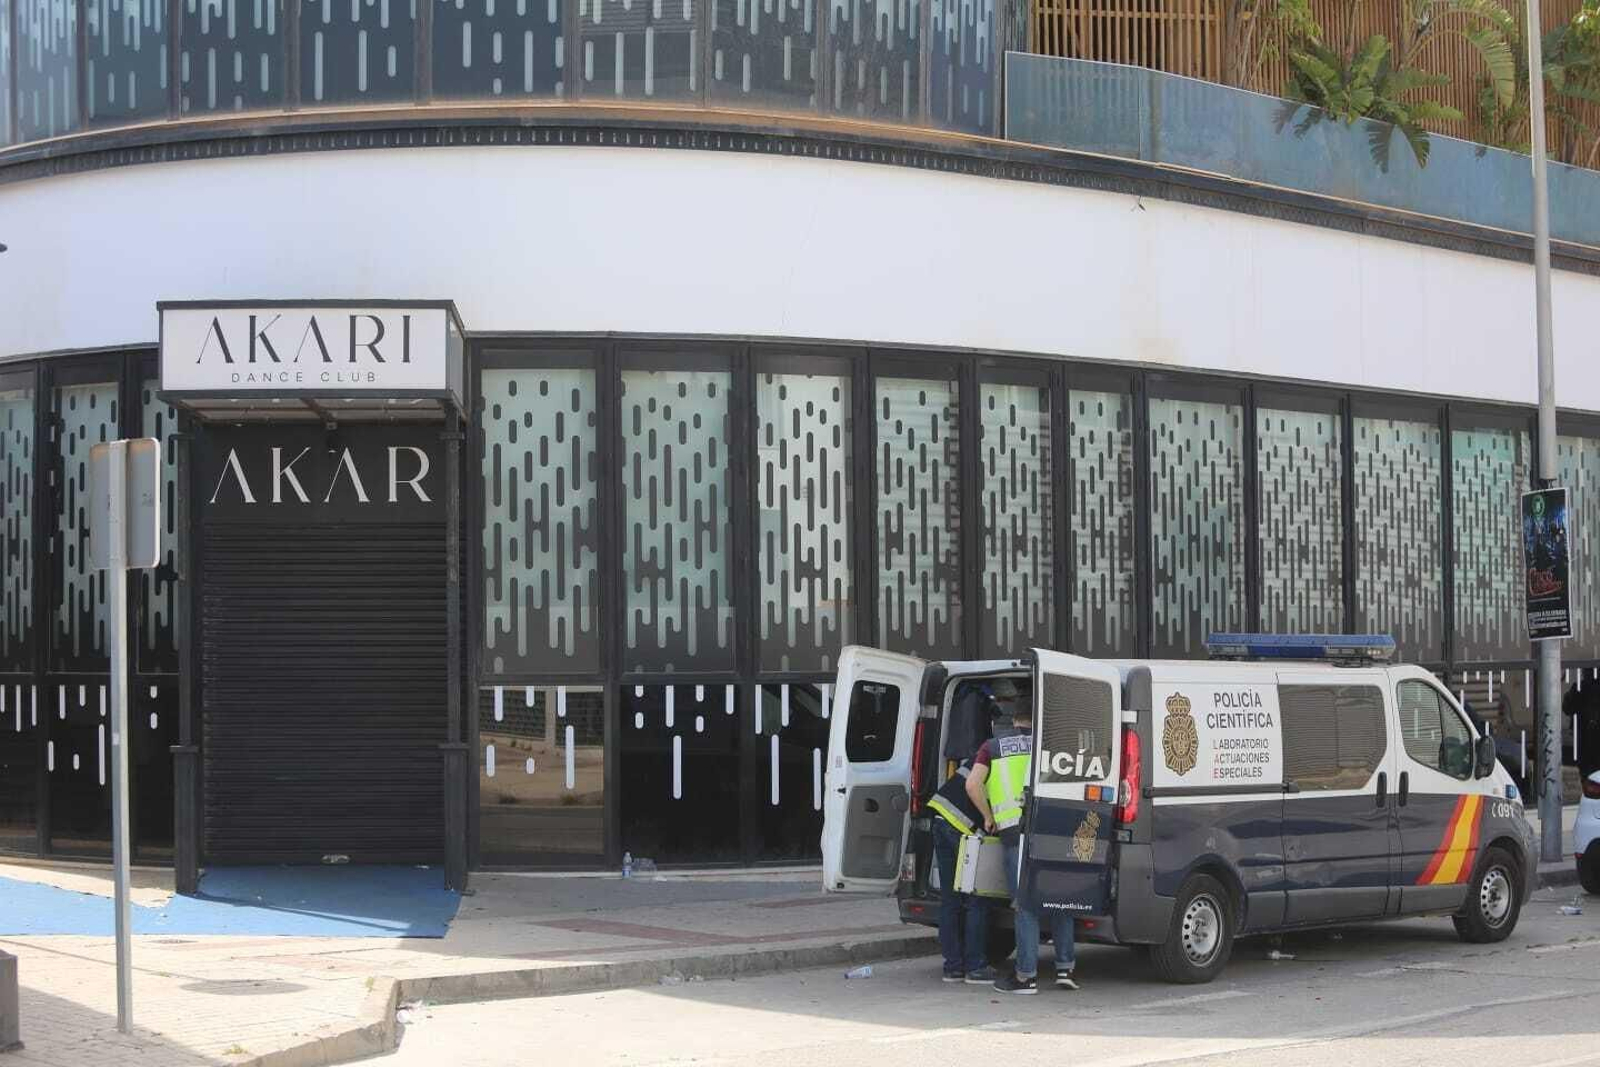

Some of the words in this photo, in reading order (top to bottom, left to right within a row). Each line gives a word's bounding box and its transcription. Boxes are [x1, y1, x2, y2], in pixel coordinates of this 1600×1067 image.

[196, 313, 411, 364] AKARI
[231, 371, 303, 383] DANCE
[320, 371, 376, 383] CLUB
[209, 446, 432, 504] AKAR
[1213, 689, 1263, 708] POLICÍA
[1206, 710, 1274, 729] CIENTÍFICA
[1001, 741, 1031, 755] POLI
[1213, 738, 1269, 750] LABORATORIO
[1214, 752, 1270, 764] ACTUACIONES
[1213, 766, 1263, 779] ESPECIALES
